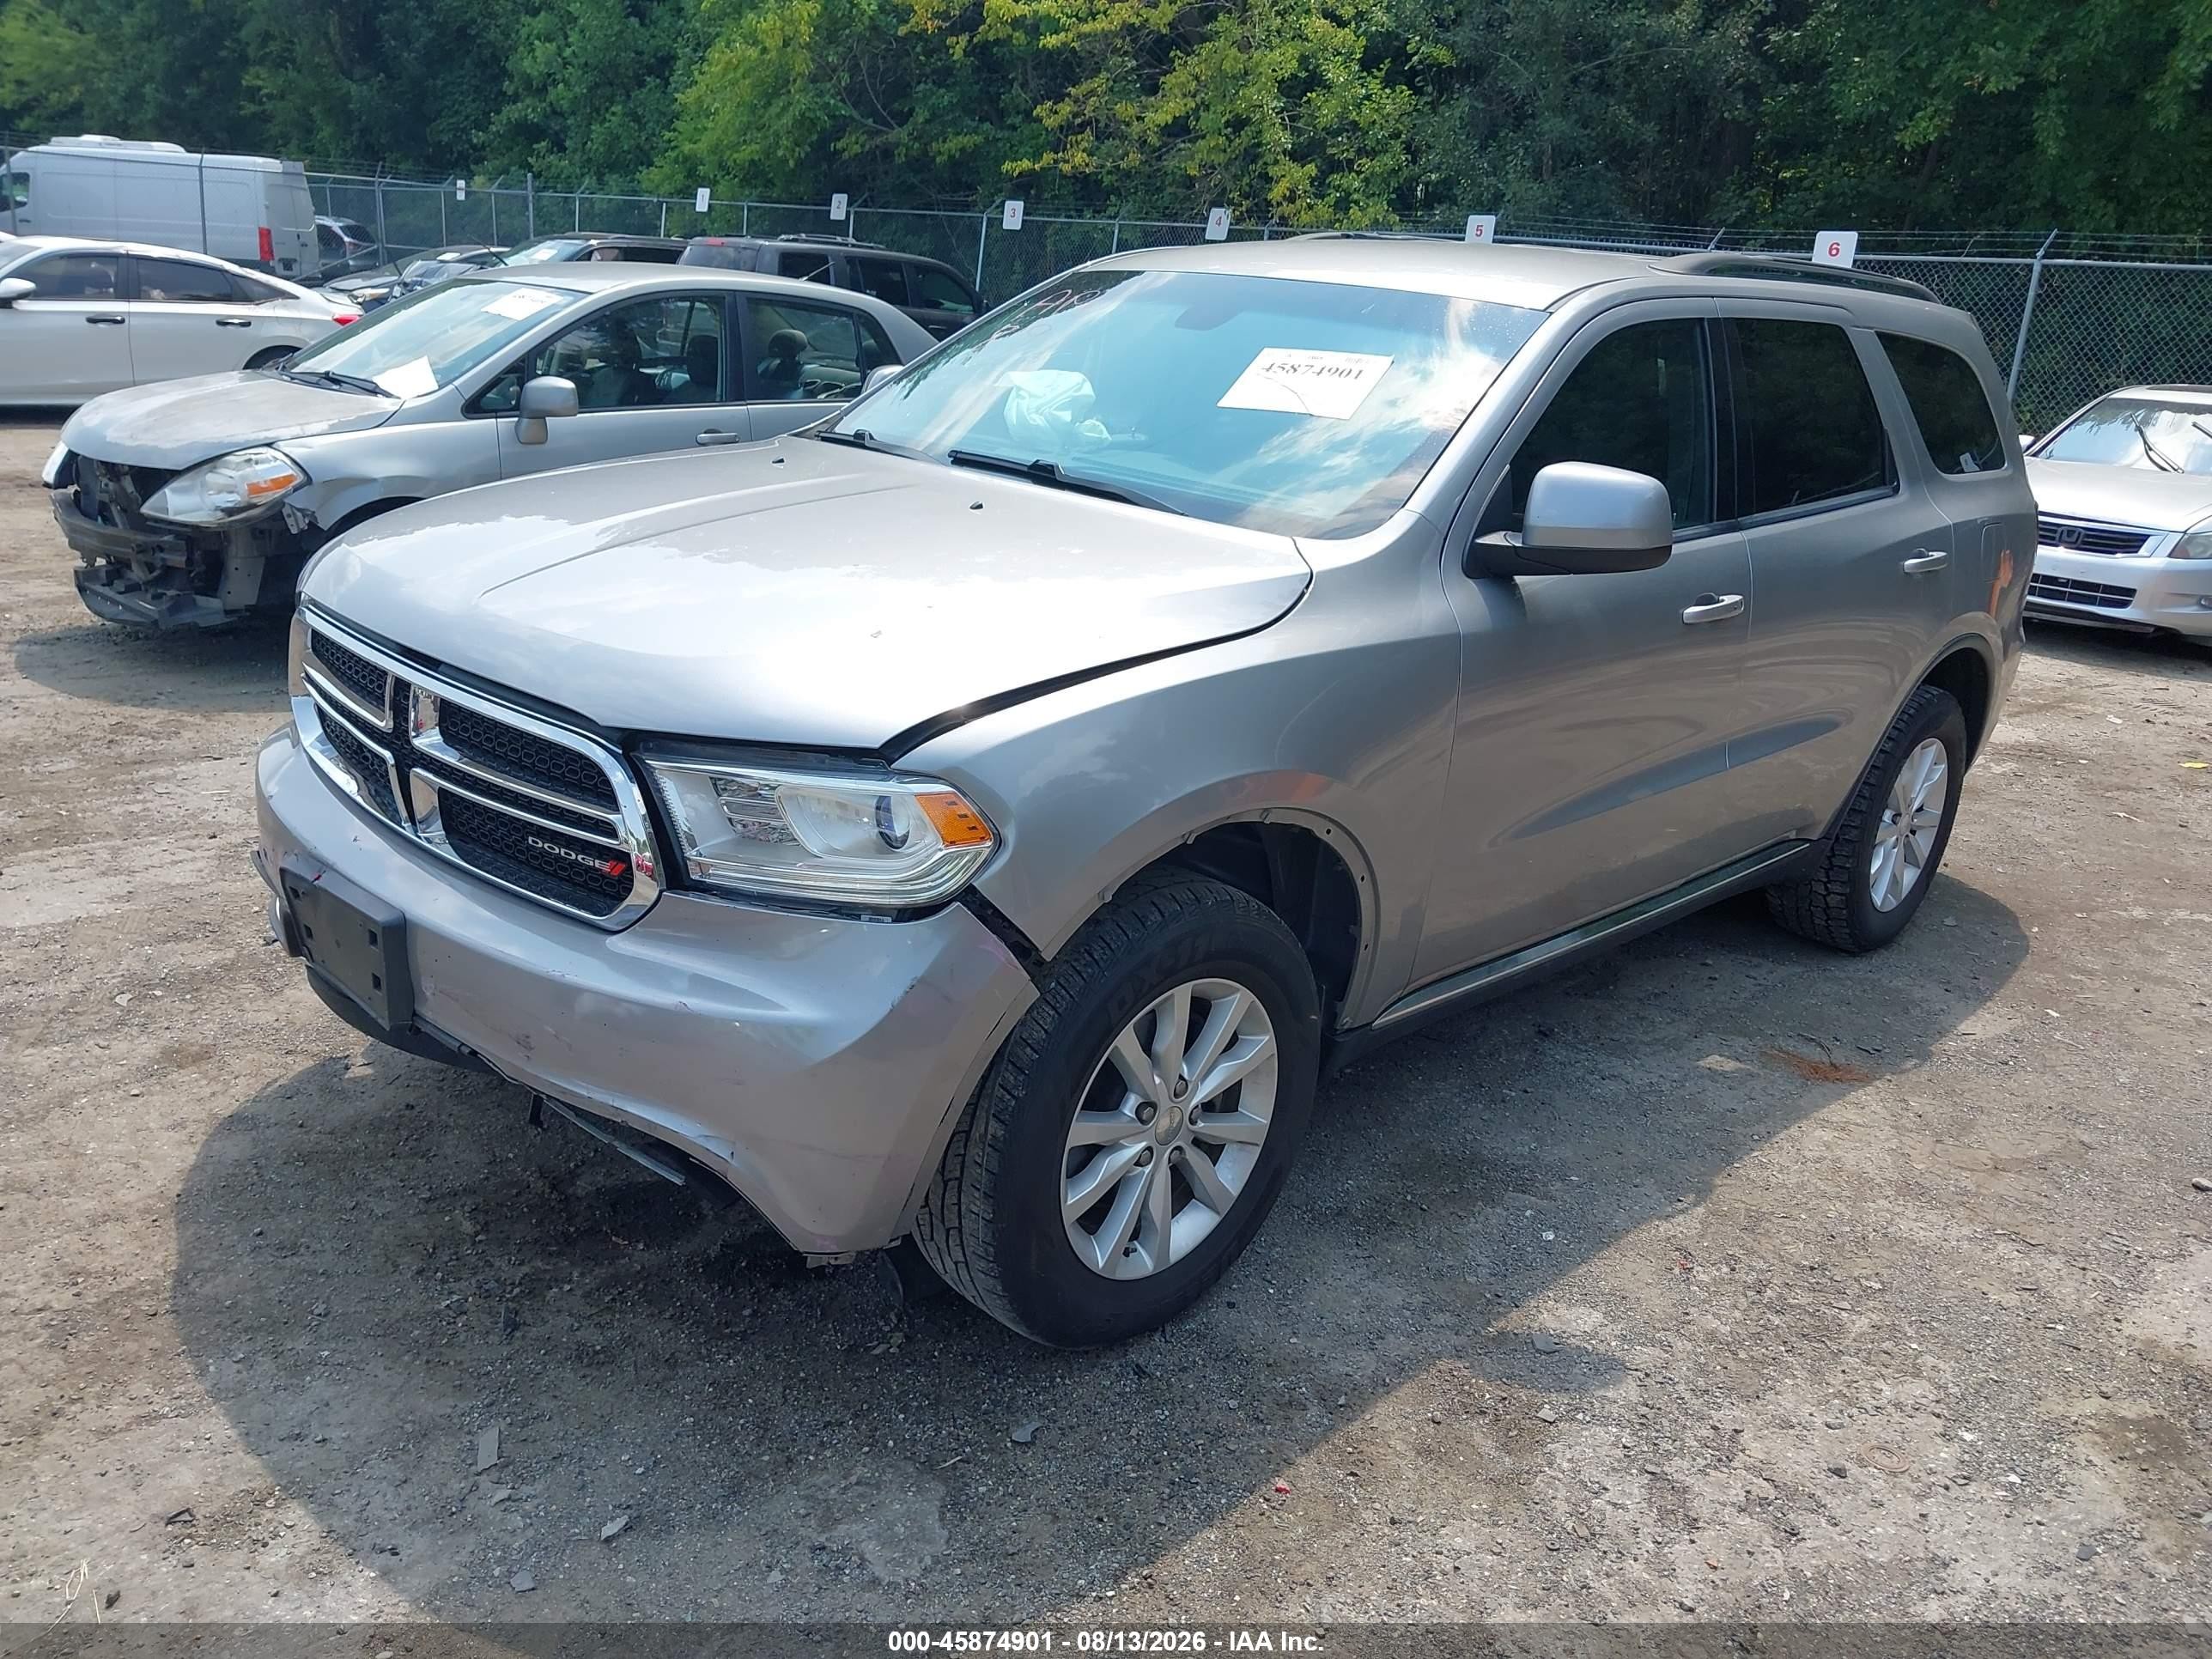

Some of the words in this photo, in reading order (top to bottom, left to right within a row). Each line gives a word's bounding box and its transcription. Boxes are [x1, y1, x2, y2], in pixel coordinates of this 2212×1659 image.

[836, 200, 842, 210] 2
[1010, 208, 1017, 218] 3
[1215, 216, 1222, 228] 4
[1475, 225, 1484, 237] 5
[1828, 242, 1840, 257] 6
[1261, 362, 1364, 380] 45874901
[528, 836, 611, 872] DODGE
